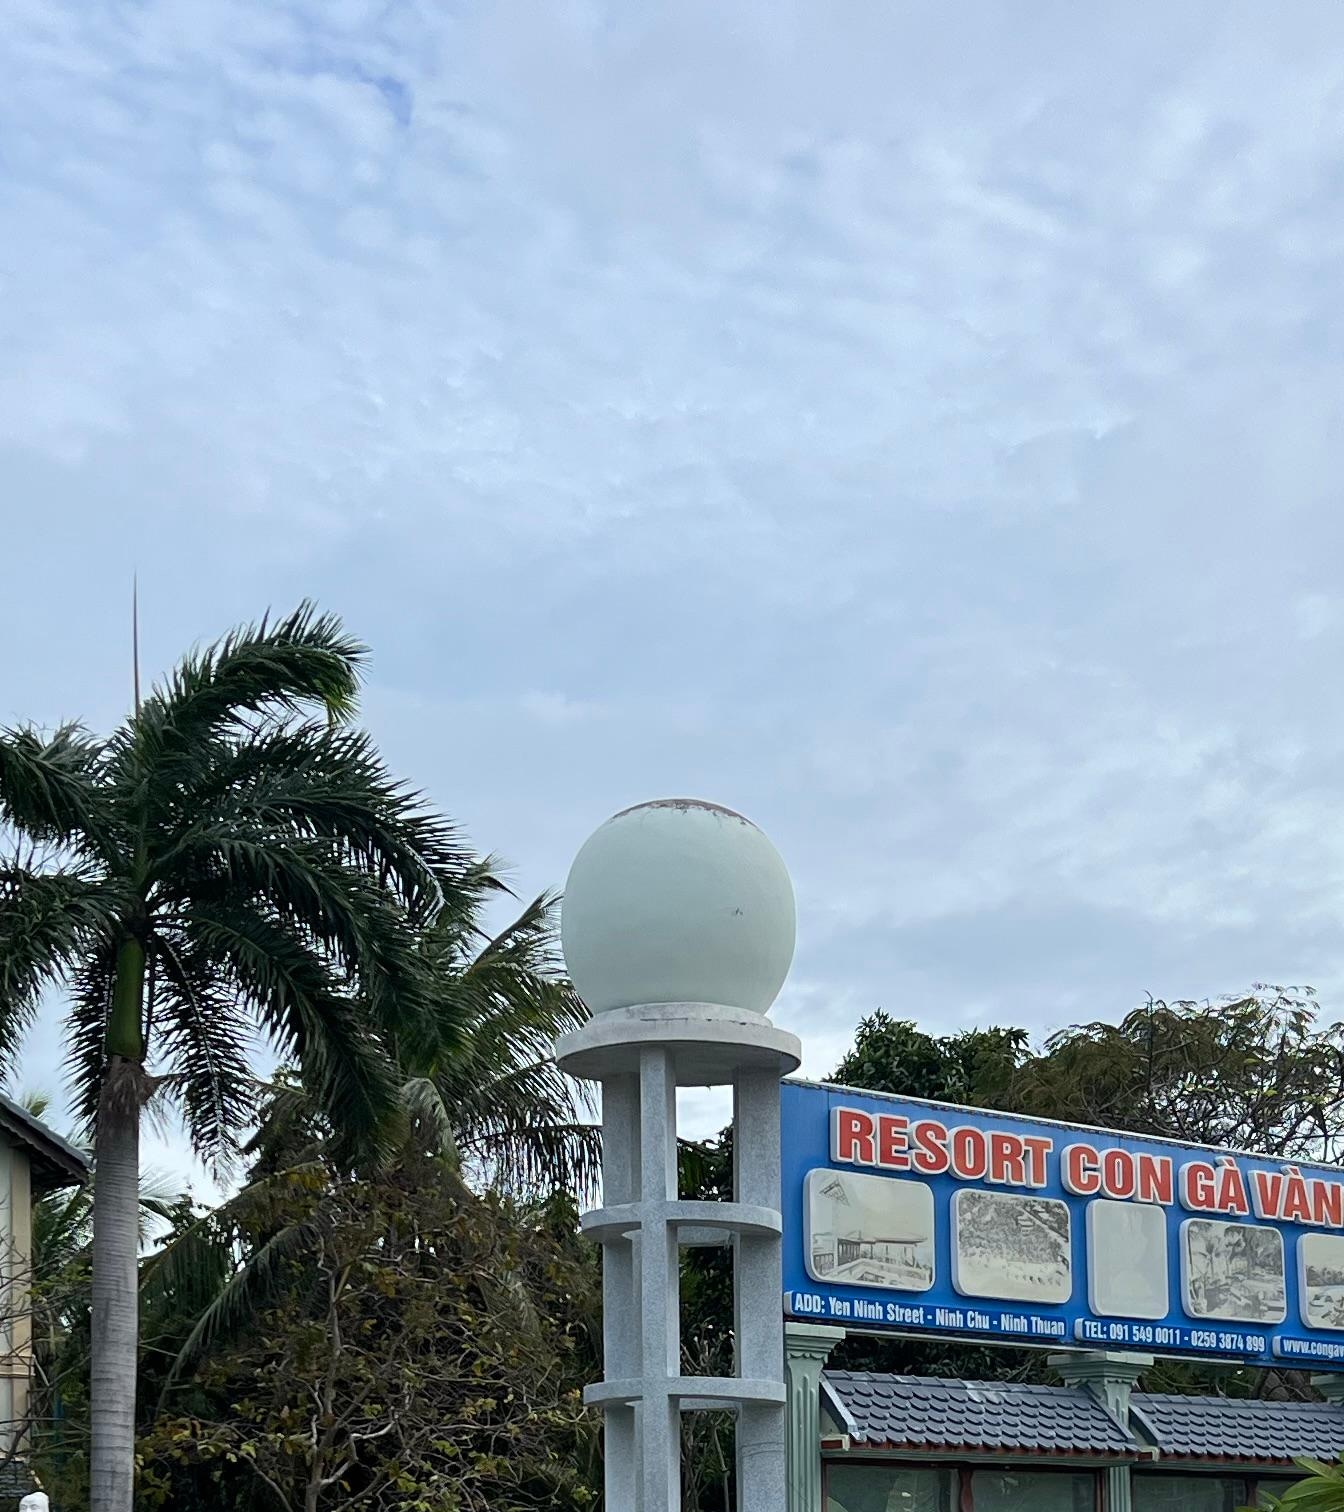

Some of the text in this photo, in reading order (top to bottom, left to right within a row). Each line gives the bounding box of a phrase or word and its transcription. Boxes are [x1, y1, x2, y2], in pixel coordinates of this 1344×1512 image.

[833, 1108, 1053, 1187] RESORT
[1063, 1143, 1172, 1205] CON
[1182, 1157, 1249, 1215] GÀ
[794, 1293, 825, 1314] ADD:
[828, 1296, 850, 1316] Yen
[854, 1299, 883, 1320] Ninh
[887, 1304, 924, 1325] Street
[935, 1308, 963, 1328] Ninh
[967, 1310, 990, 1330] Chu
[1000, 1315, 1027, 1333] Ninh
[1030, 1316, 1065, 1336] Thuan
[1085, 1320, 1107, 1339] TEL:
[1109, 1323, 1129, 1341] 091
[1132, 1325, 1153, 1343] 549
[1155, 1327, 1180, 1345] 0011
[1191, 1330, 1217, 1348] 0259
